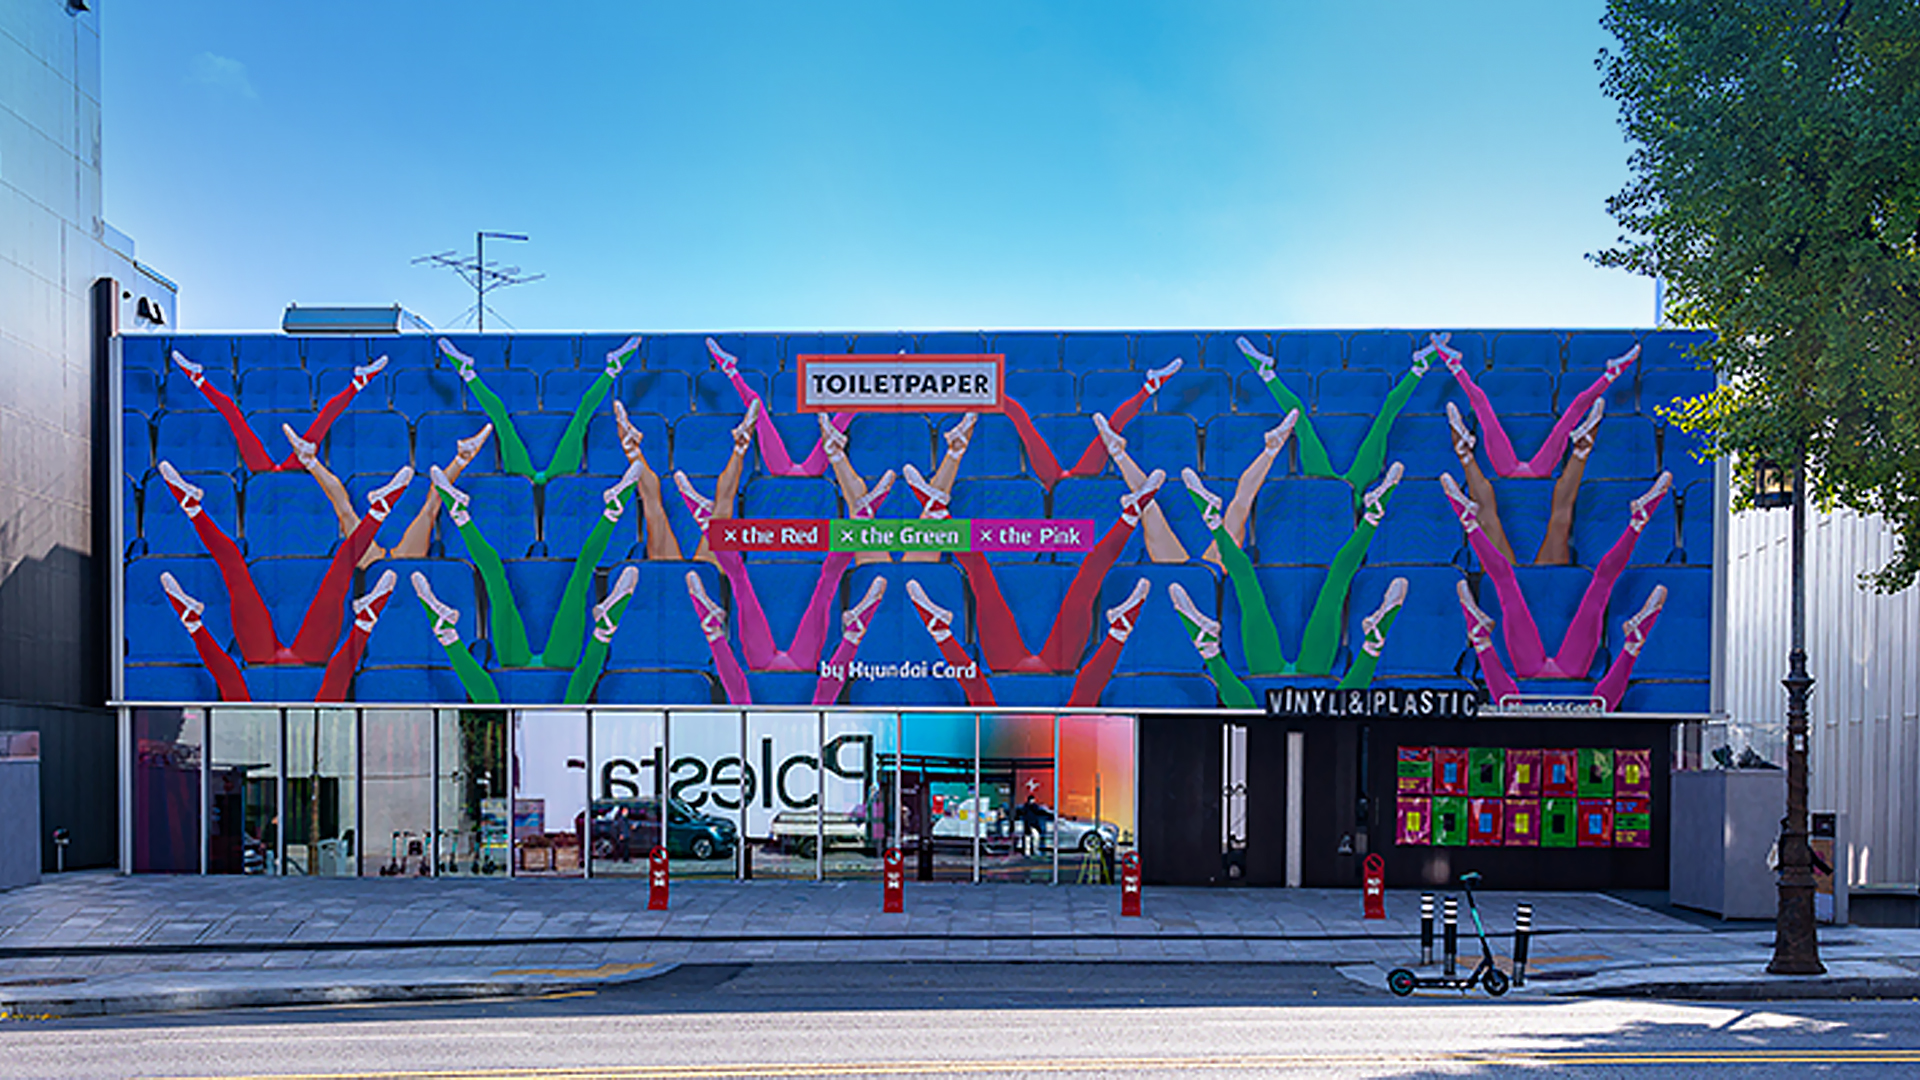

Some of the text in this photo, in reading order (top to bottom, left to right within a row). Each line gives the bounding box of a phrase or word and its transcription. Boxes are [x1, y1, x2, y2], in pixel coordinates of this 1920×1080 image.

[812, 373, 990, 395] TOILETPAPER
[741, 526, 775, 545] the
[780, 526, 818, 545] Red
[861, 526, 895, 545] the
[899, 526, 959, 545] Green
[999, 526, 1032, 545] the
[1039, 526, 1081, 545] Pink
[820, 660, 978, 682] by Hyundai Card
[1269, 690, 1339, 716] VINYL
[1373, 690, 1476, 717] PLASTIC
